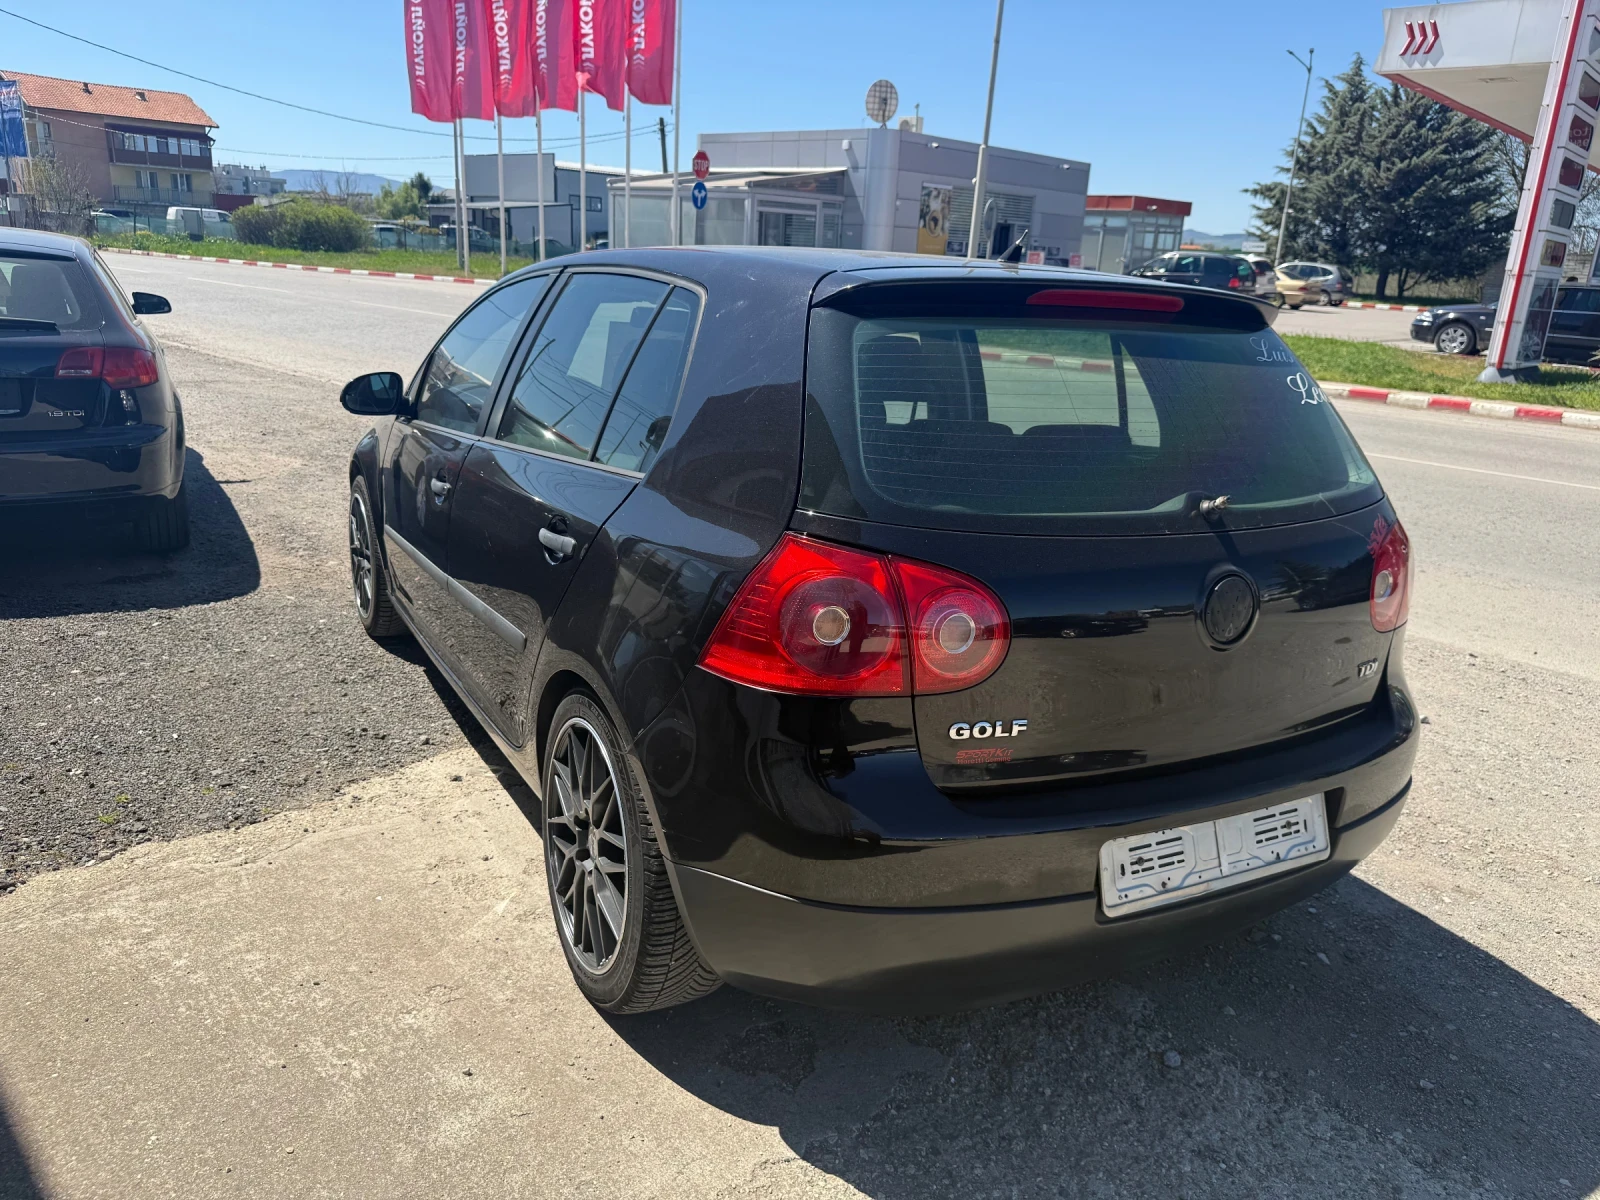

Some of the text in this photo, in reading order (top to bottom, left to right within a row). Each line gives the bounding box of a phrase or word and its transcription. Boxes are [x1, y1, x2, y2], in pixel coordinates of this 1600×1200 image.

[694, 160, 709, 171] STOP
[1359, 661, 1379, 678] TDI
[948, 719, 1028, 740] GOLF
